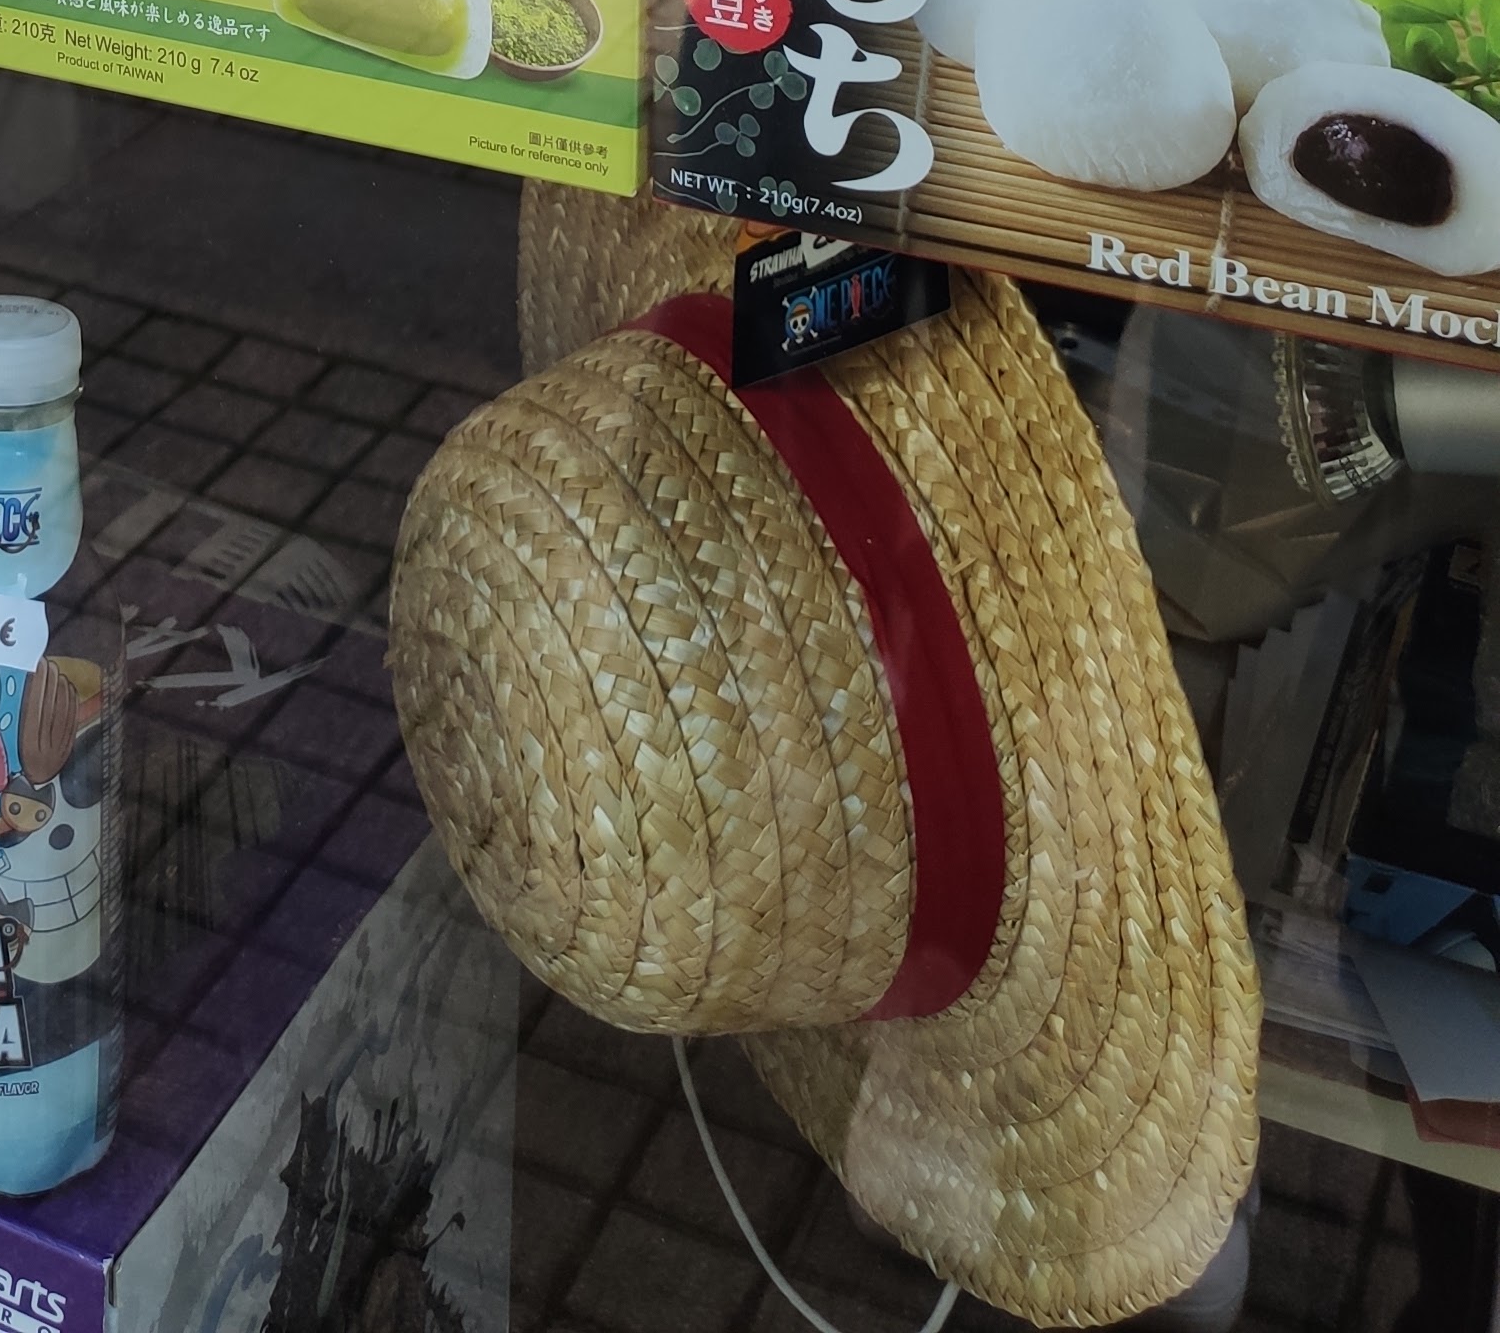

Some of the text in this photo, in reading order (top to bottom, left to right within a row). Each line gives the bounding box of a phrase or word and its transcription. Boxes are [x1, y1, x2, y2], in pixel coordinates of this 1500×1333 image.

[468, 136, 610, 177] Picture for reference only
[1085, 231, 1192, 288] Red
[1209, 256, 1349, 321] Bean
[0, 1081, 39, 1095] FLAVOR
